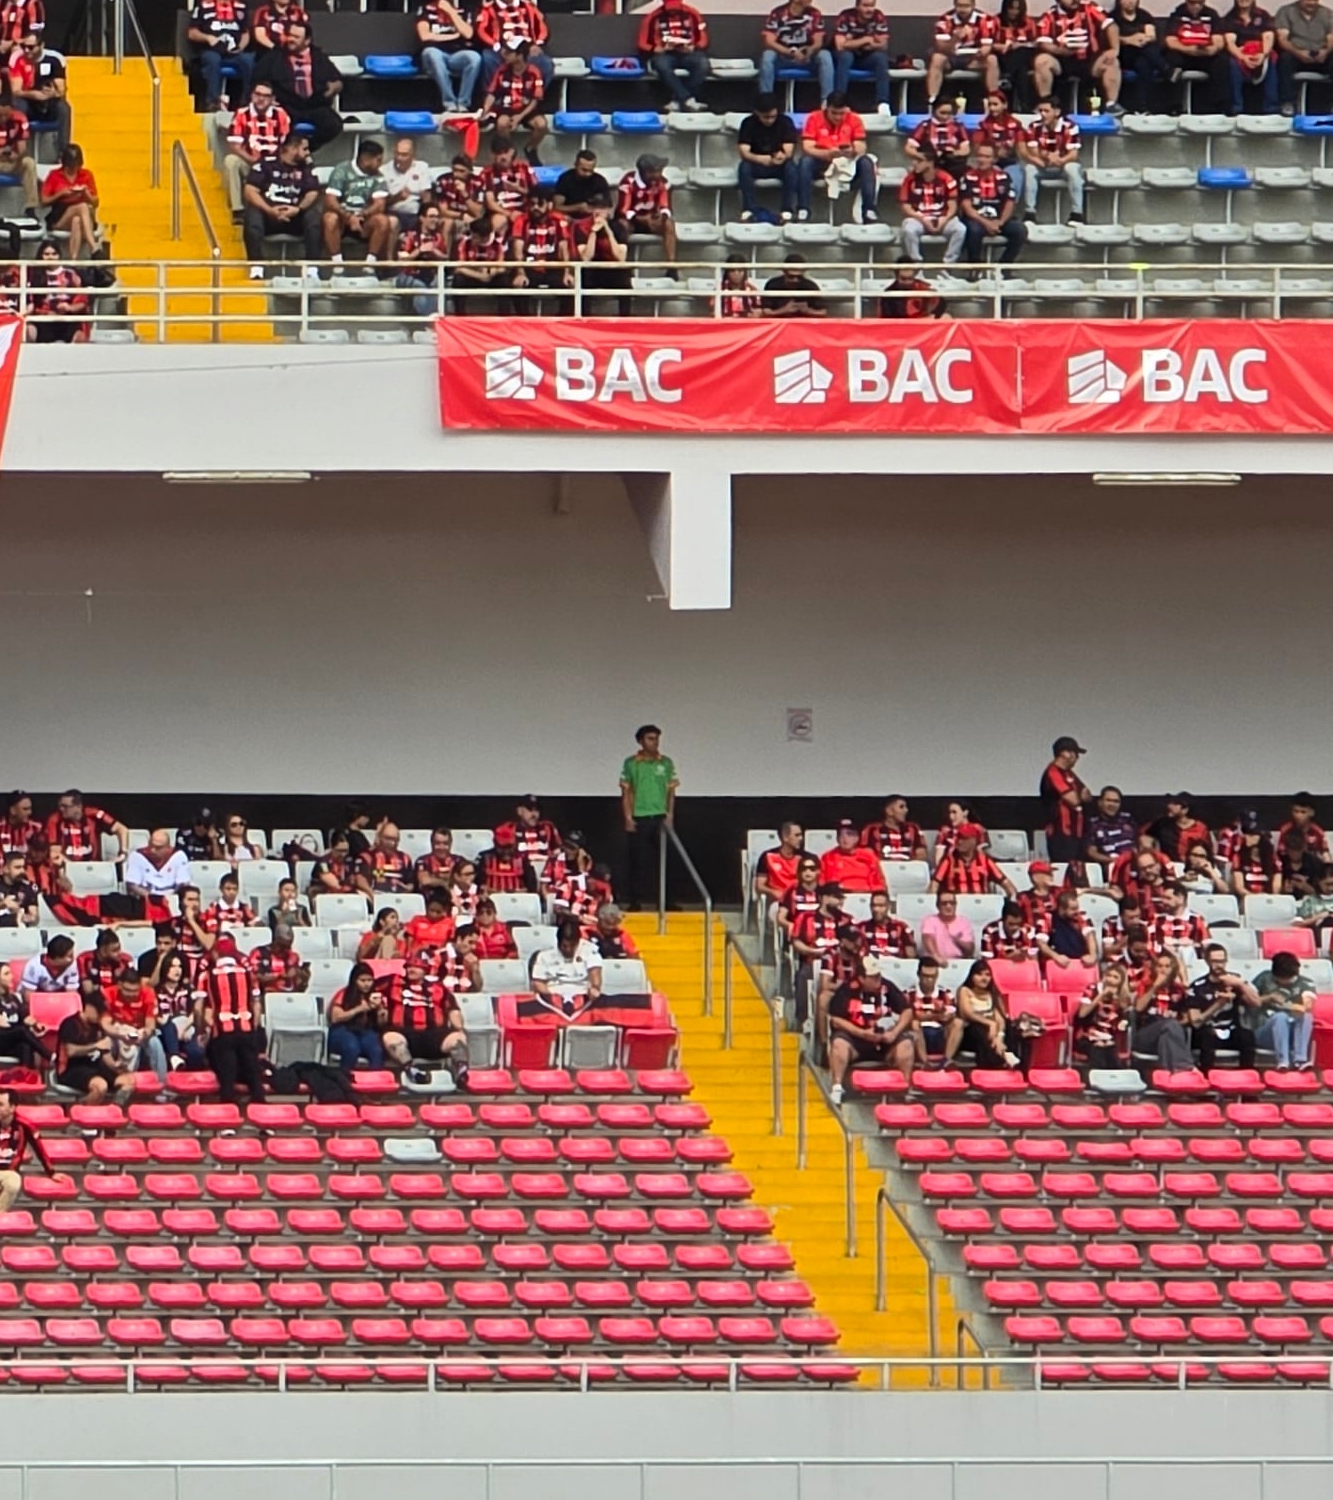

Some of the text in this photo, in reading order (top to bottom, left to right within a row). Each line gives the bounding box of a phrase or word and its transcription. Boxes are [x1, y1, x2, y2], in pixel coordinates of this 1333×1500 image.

[553, 346, 683, 403] BAC
[846, 348, 973, 404] BAC
[1142, 347, 1268, 404] BAC
